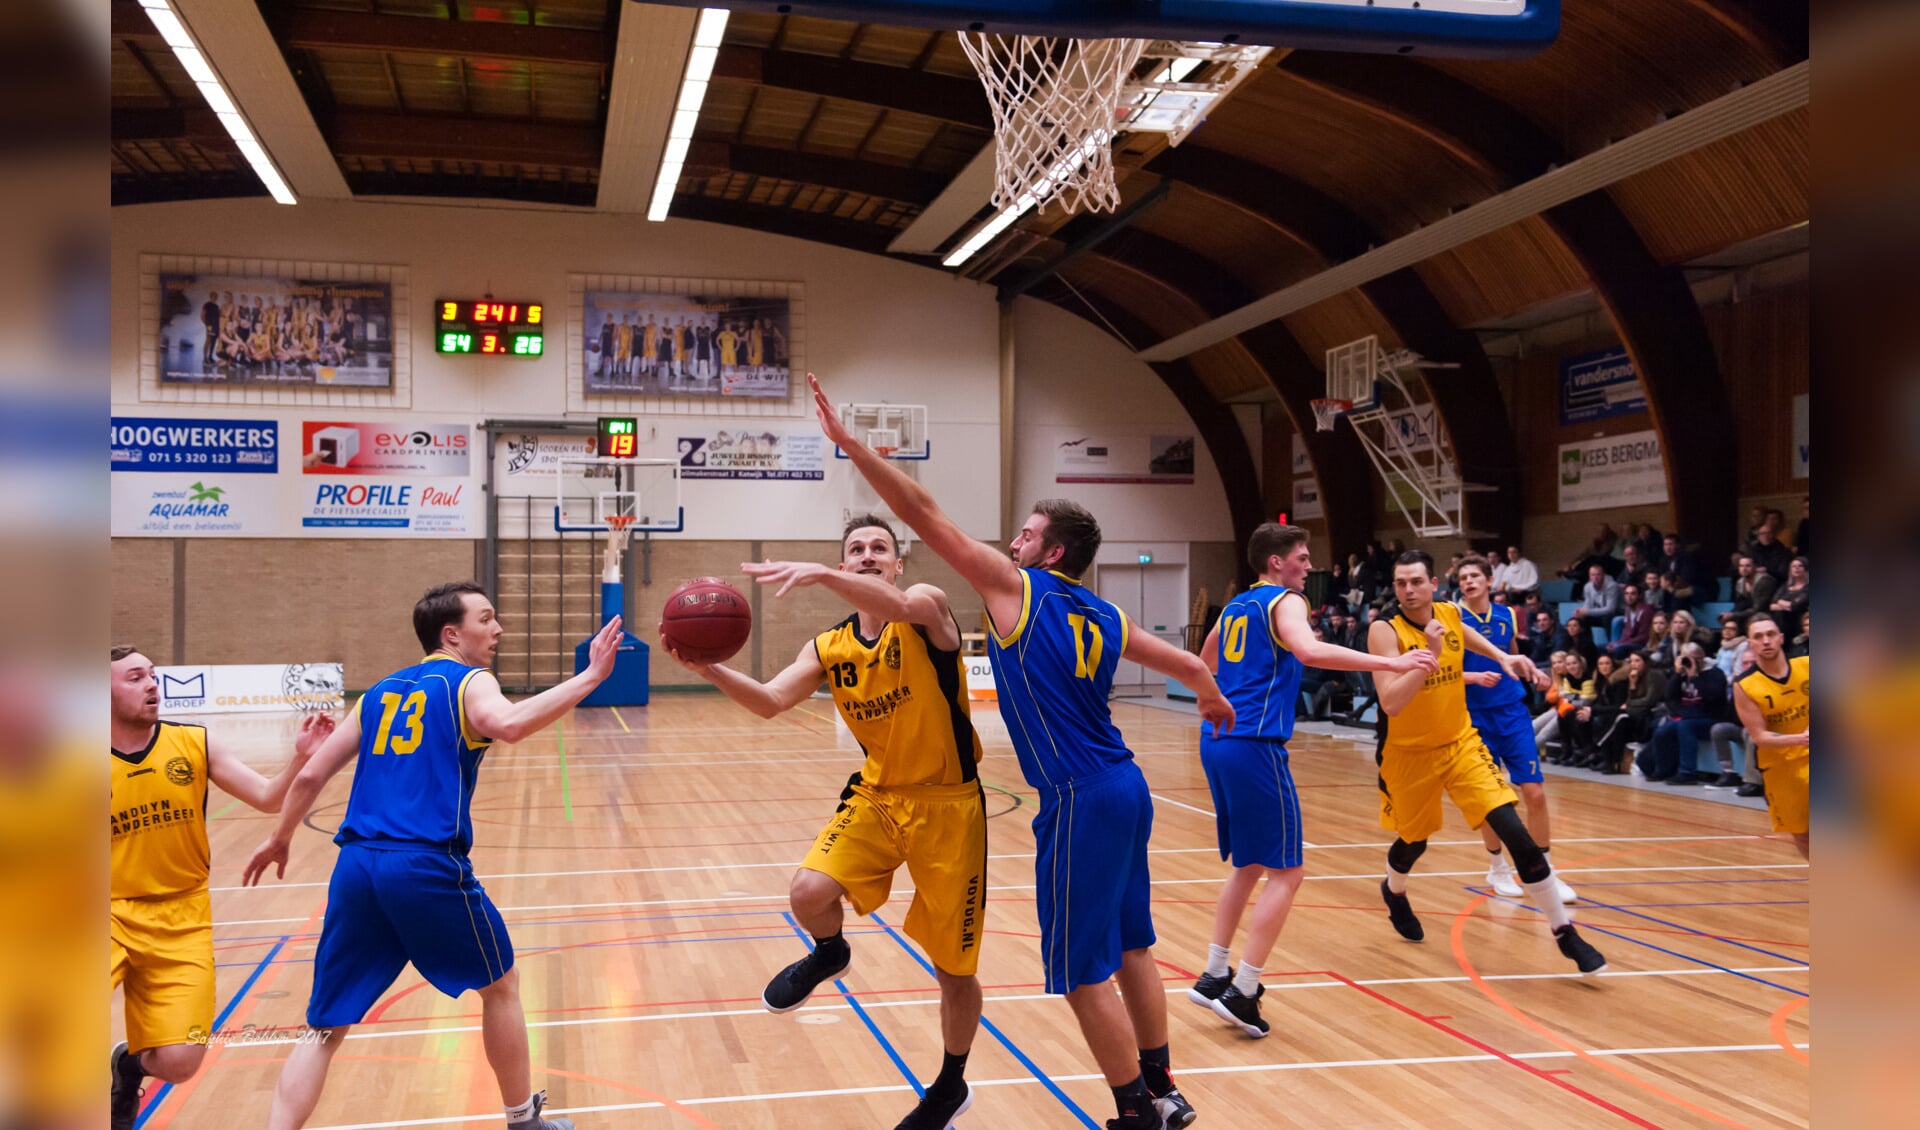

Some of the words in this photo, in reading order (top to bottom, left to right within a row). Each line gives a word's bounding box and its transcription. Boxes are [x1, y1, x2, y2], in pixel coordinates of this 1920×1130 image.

[443, 303, 457, 320] 3
[527, 306, 542, 323] 5
[443, 334, 471, 352] 54
[515, 336, 542, 354] 26
[111, 426, 275, 448] HOOGWERKERS
[611, 435, 633, 455] 19
[149, 452, 170, 463] 071
[174, 453, 182, 463] 5
[185, 453, 207, 463] 320
[212, 453, 232, 464] 123
[1582, 447, 1609, 467] KEES
[316, 484, 412, 505] PROFILE
[420, 484, 463, 507] Paul
[149, 503, 229, 519] AQUAMAR
[313, 507, 326, 515] DE
[329, 507, 408, 515] FIETSSPECIALIST
[173, 523, 191, 531] een
[1498, 622, 1507, 636] 7
[1067, 613, 1103, 682] 11
[1223, 615, 1248, 663] 10
[829, 662, 858, 688] 13
[164, 699, 205, 709] GROEP
[215, 692, 343, 706] GRASSHOPPERS
[372, 690, 427, 755] 13
[1529, 761, 1537, 775] 7
[835, 818, 852, 830] DE
[820, 833, 840, 854] WIT
